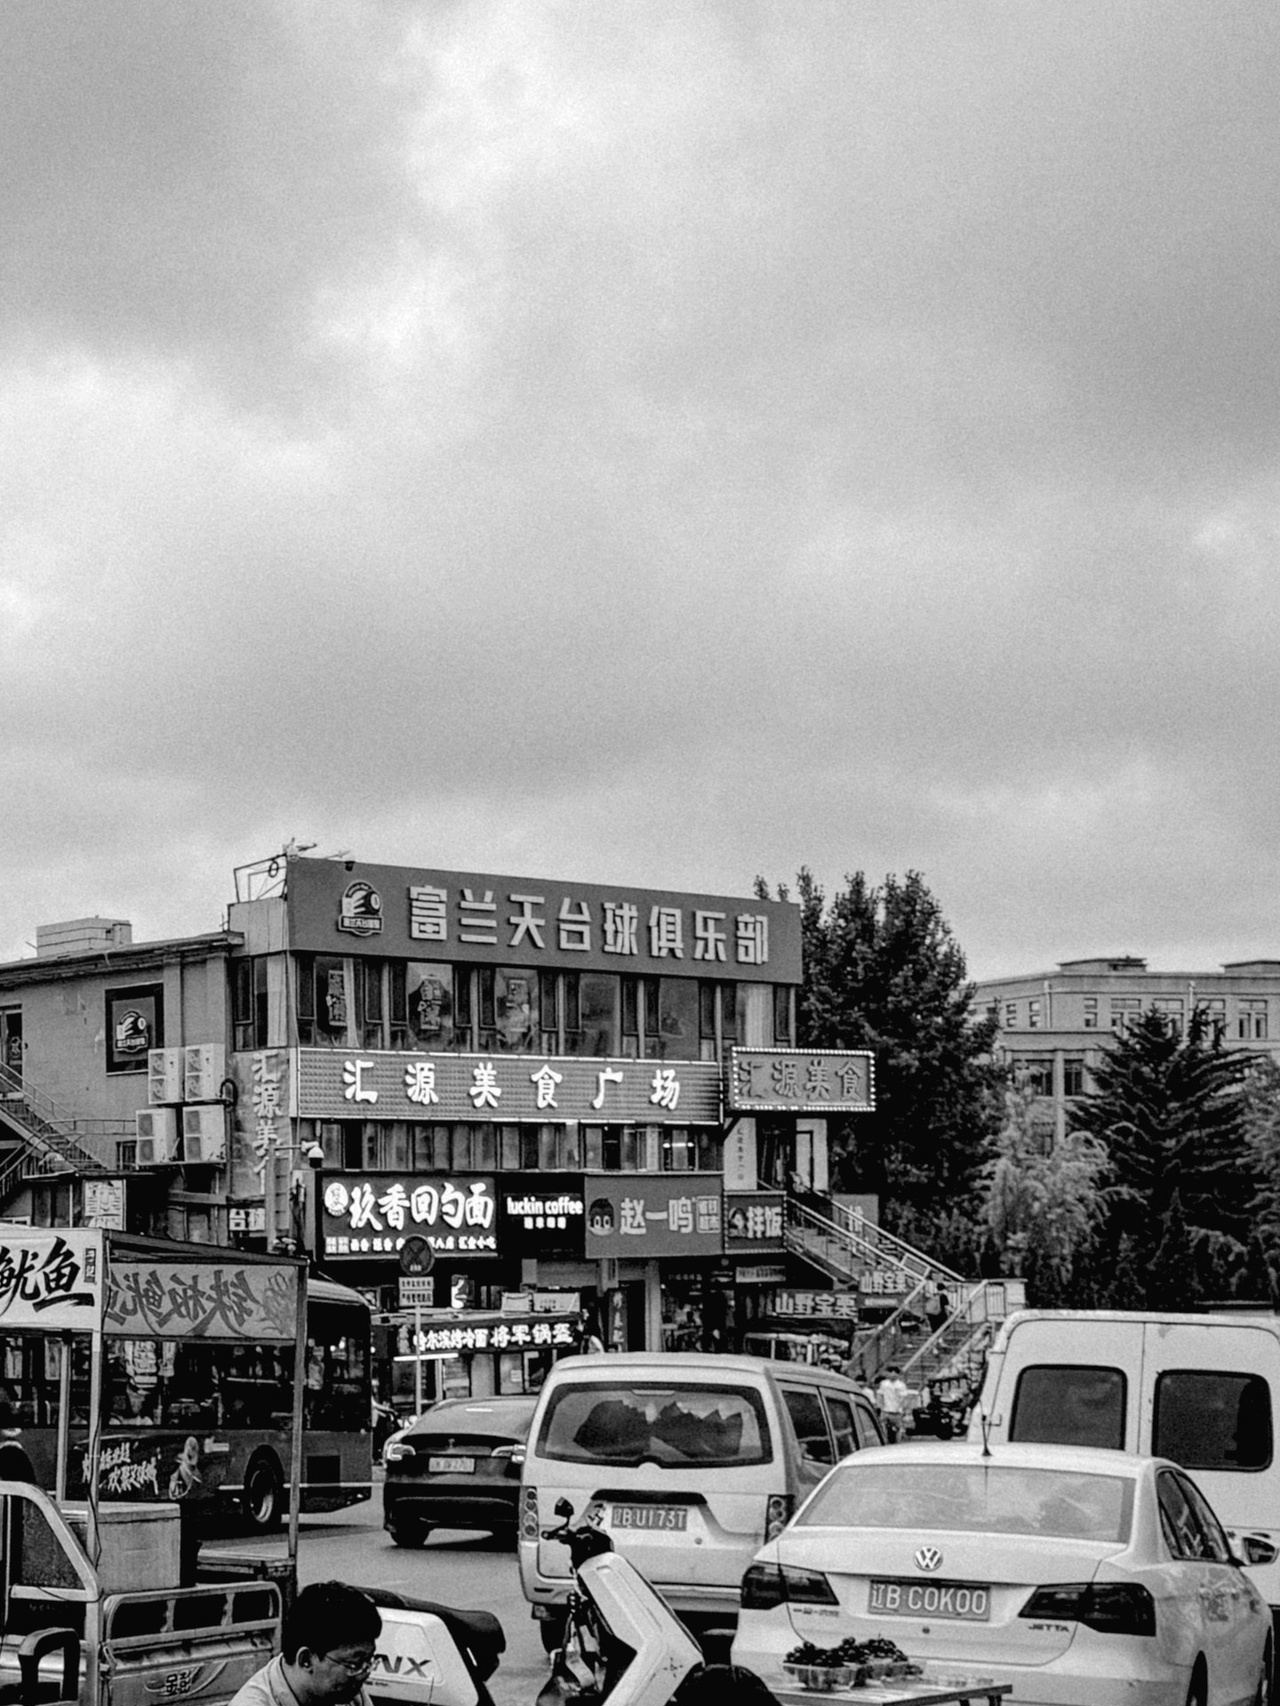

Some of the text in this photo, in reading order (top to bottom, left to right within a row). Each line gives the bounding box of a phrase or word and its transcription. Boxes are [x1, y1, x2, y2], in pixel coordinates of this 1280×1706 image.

[410, 885, 769, 965] 富兰天台球俱乐部
[344, 1060, 680, 1109] 汇源美食广场
[738, 1058, 862, 1101] 汇源美食
[506, 1196, 583, 1215] luckin coffee
[620, 1198, 693, 1235] 赵一鸣
[1028, 1623, 1070, 1633] JETTA
